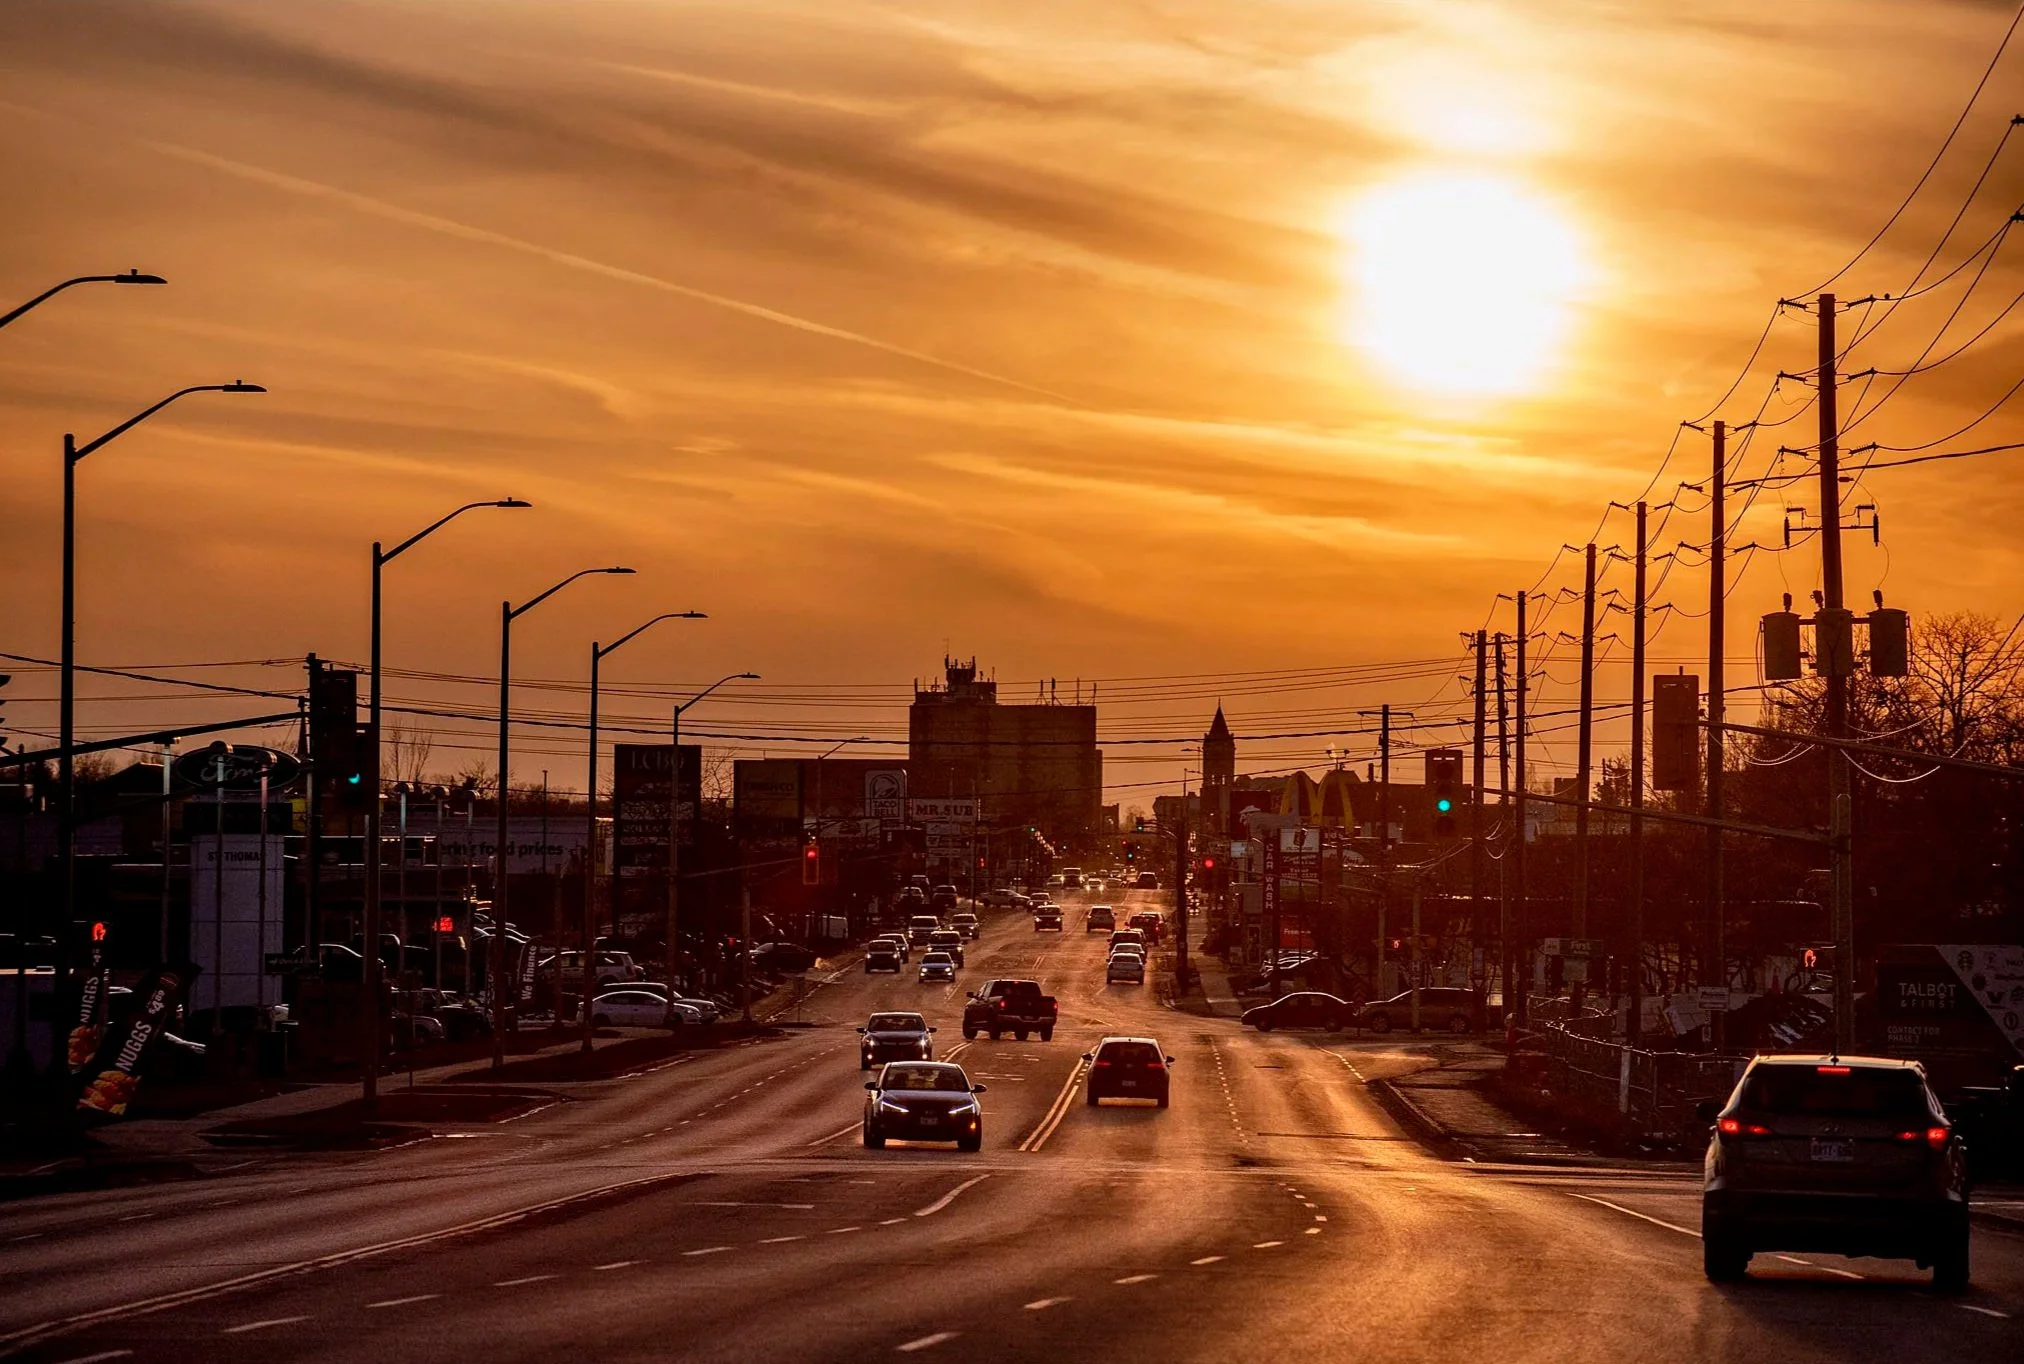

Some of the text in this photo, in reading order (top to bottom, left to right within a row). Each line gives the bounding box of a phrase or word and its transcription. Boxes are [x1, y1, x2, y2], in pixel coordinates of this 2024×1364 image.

[873, 800, 897, 808] TACO
[874, 808, 897, 817] BELL
[223, 851, 266, 861] THOMA
[479, 841, 515, 855] fod
[518, 841, 563, 858] prices
[1265, 843, 1275, 910] CAR WASH
[520, 945, 538, 1000] We Finance
[1897, 981, 1957, 998] TALBOT
[79, 976, 100, 1024] NUGGS
[1912, 998, 1957, 1011] FIRST
[114, 1020, 153, 1072] NUGGS
